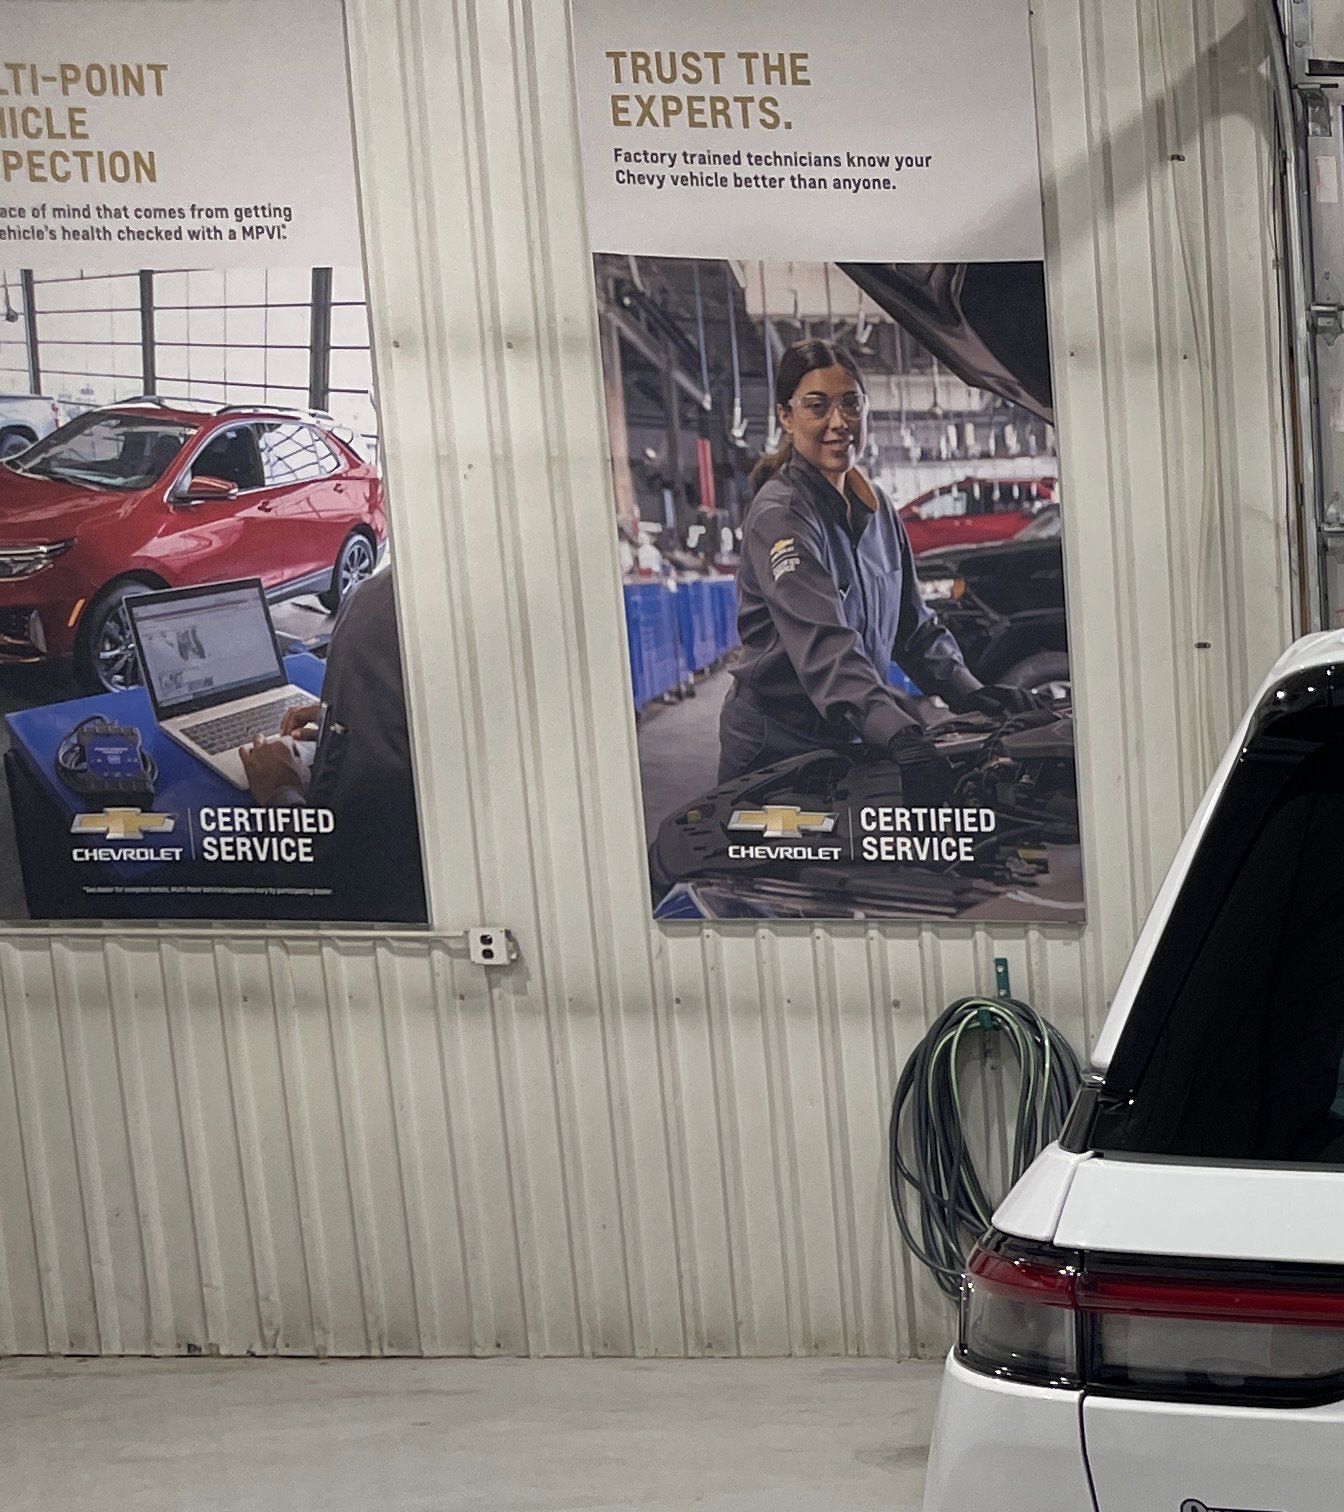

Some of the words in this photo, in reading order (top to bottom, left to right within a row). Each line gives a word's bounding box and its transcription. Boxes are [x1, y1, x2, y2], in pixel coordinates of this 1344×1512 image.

[605, 50, 726, 85] TRUST
[737, 52, 811, 86] THE
[610, 94, 793, 130] EXPERTS.
[613, 147, 677, 168] Factory
[682, 149, 742, 167] trained
[746, 150, 842, 167] technicians
[846, 152, 890, 168] know
[895, 155, 932, 171] your
[615, 169, 666, 190] Chevy
[670, 171, 728, 188] vehicle
[733, 172, 785, 189] better
[790, 174, 828, 190] than
[832, 177, 897, 194] anyone.
[32, 203, 46, 219] of
[52, 203, 91, 219] mind
[96, 203, 130, 219] that
[134, 206, 186, 219] comes
[190, 203, 229, 219] from
[234, 203, 293, 223] getting
[61, 225, 112, 241] health
[117, 225, 183, 241] checked
[187, 225, 223, 241] with
[228, 228, 237, 241] a
[200, 807, 335, 834] CERTIFIED
[859, 806, 996, 833] CERTIFIED
[72, 846, 183, 862] CHEVROLET
[202, 837, 314, 863] SERVICE
[728, 845, 842, 861] CHEVROLET
[862, 836, 975, 862] SERVICE
